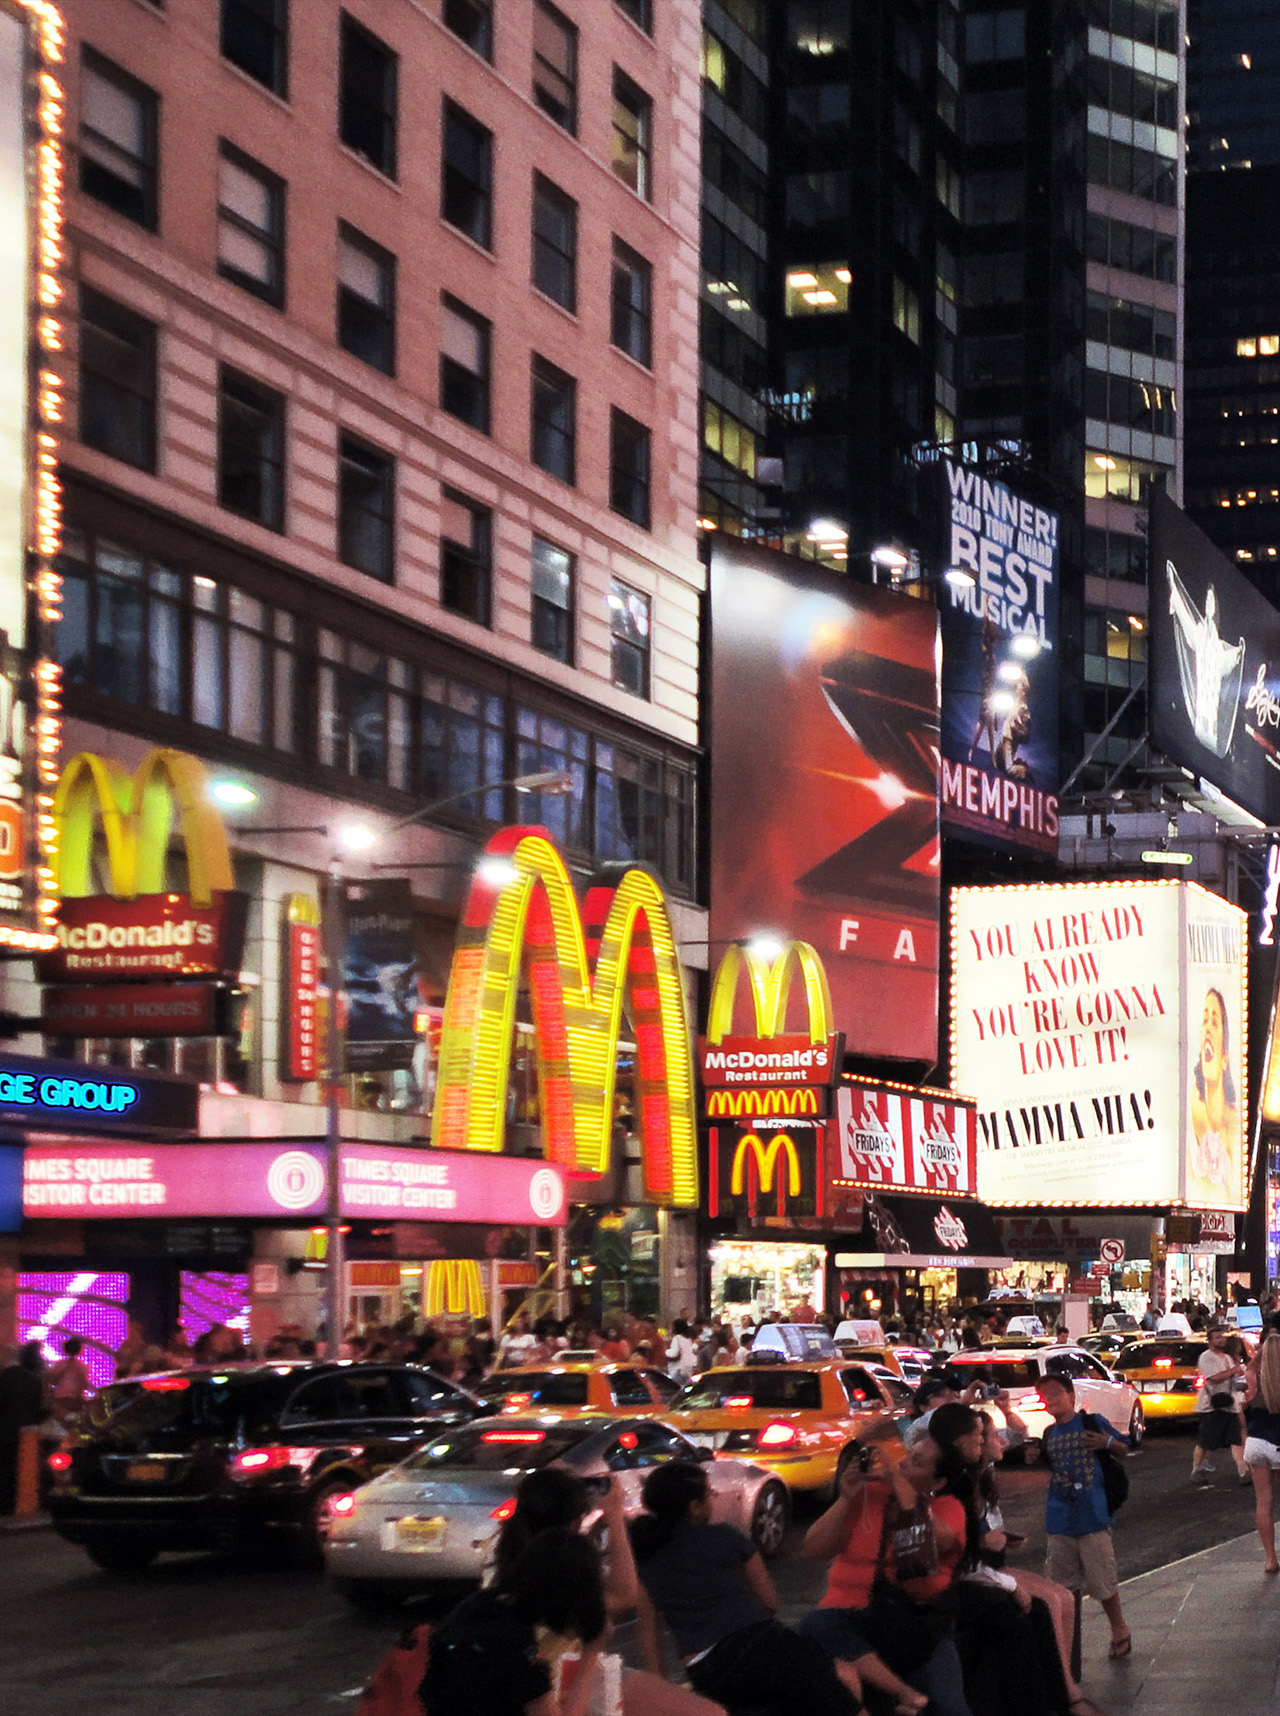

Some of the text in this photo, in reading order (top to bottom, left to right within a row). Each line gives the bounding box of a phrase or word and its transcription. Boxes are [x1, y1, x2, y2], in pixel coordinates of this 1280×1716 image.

[946, 460, 1058, 548] WINNER!
[952, 499, 981, 532] 2010
[985, 513, 1014, 549] TONY
[952, 523, 1053, 616] BEST
[951, 583, 1053, 650] MUSICAL
[942, 758, 1059, 837] MEMPHIS
[970, 903, 1147, 961] YOU ALREADY
[66, 952, 185, 969] Restaurant
[1023, 950, 1102, 994] KNOW
[972, 982, 1167, 1040] YOU'RE GONNA
[705, 1049, 828, 1069] McDonald's
[1019, 1026, 1130, 1075] LOVE IT!
[40, 1078, 136, 1112] GROUP
[725, 1069, 808, 1082] Restaurant
[977, 1089, 1155, 1152] MAMMA MIA!
[25, 1159, 71, 1180] IMES
[76, 1158, 153, 1182] SQUARE
[343, 1157, 388, 1180] TIMES
[392, 1162, 449, 1186] SQUARE
[23, 1182, 166, 1205] ISITOR CENTER
[343, 1182, 456, 1209] VISITOR CENTER
